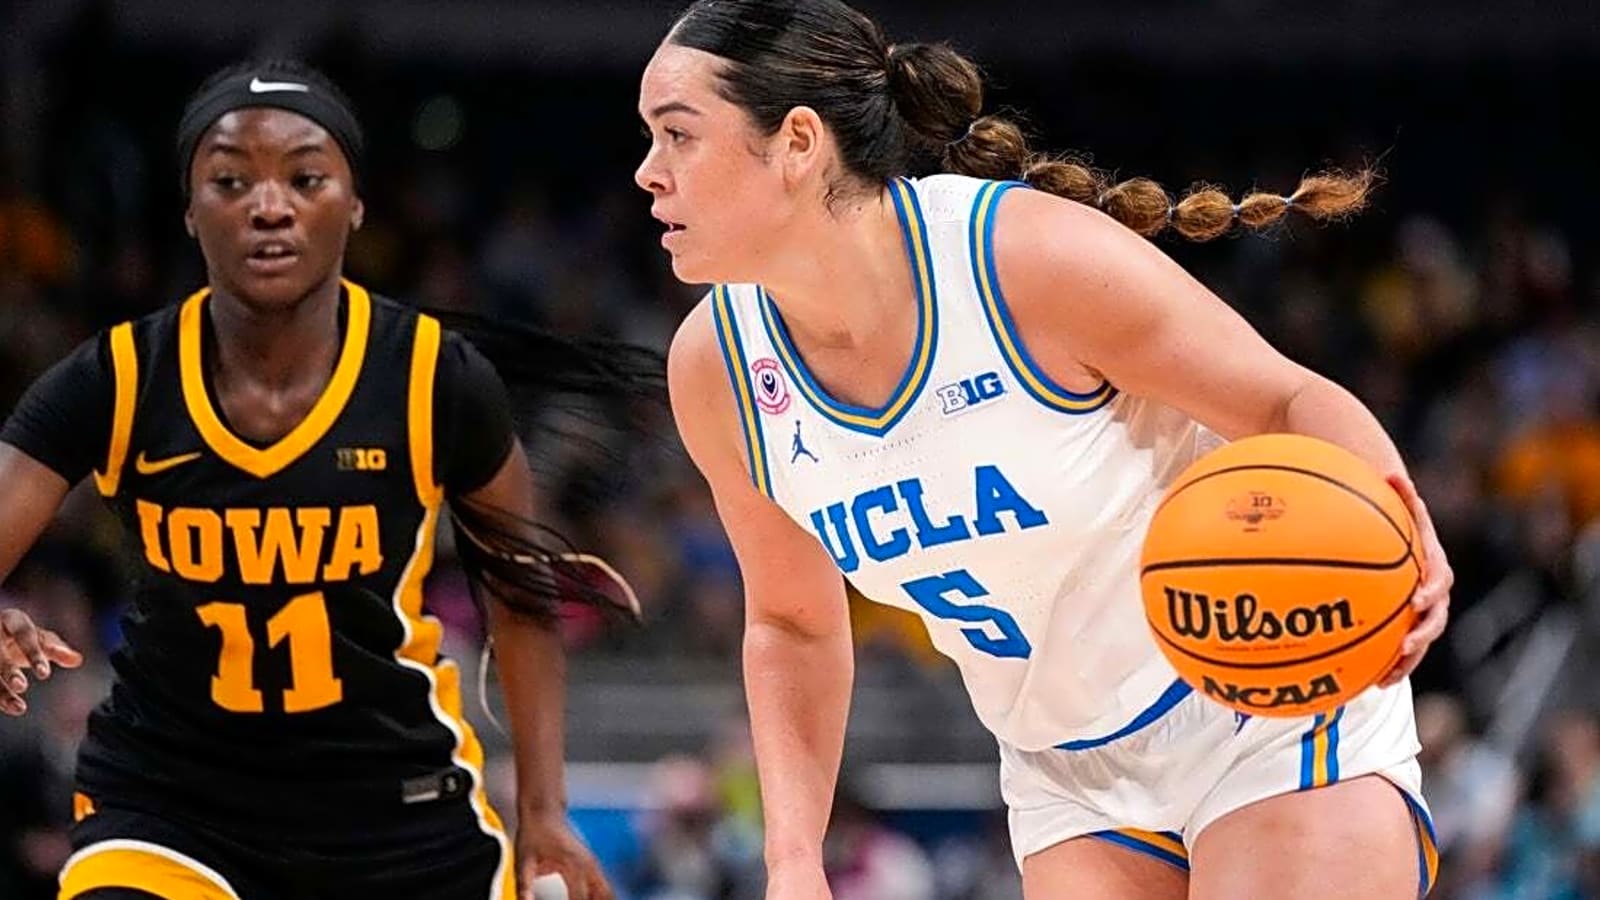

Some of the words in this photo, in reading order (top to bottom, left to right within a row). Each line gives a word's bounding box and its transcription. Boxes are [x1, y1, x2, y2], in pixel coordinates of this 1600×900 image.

[136, 499, 383, 584] IOWA
[810, 465, 1048, 573] UCLA
[195, 591, 342, 713] 11
[900, 569, 1032, 659] 5
[1164, 586, 1354, 642] Wilson
[1202, 674, 1341, 708] NCAA
